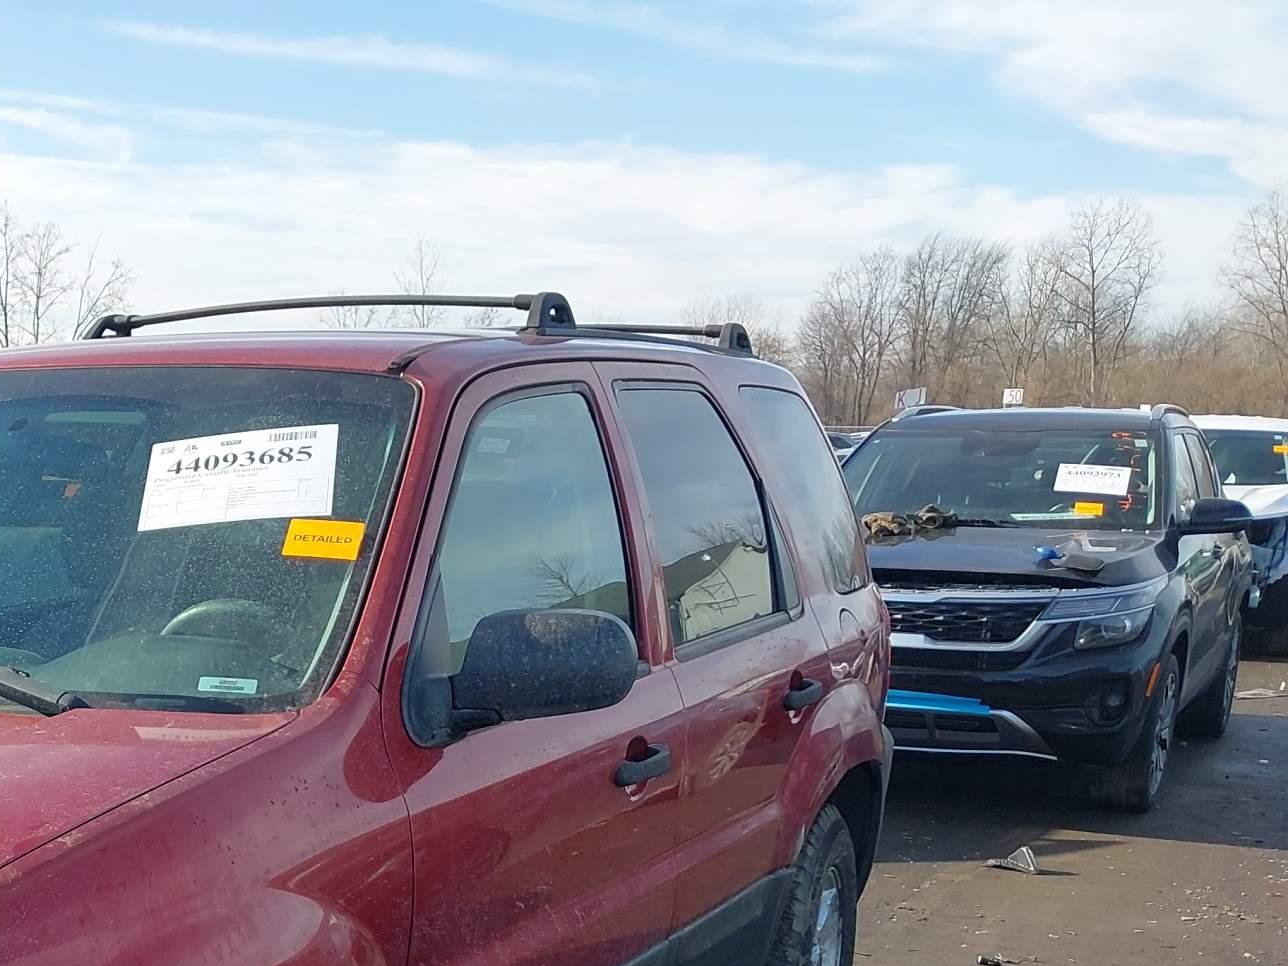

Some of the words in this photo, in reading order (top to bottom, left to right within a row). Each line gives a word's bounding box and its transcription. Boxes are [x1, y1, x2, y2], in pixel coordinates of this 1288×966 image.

[1007, 390, 1022, 403] 50
[167, 445, 313, 475] 44093685
[293, 533, 353, 544] DETAILED
